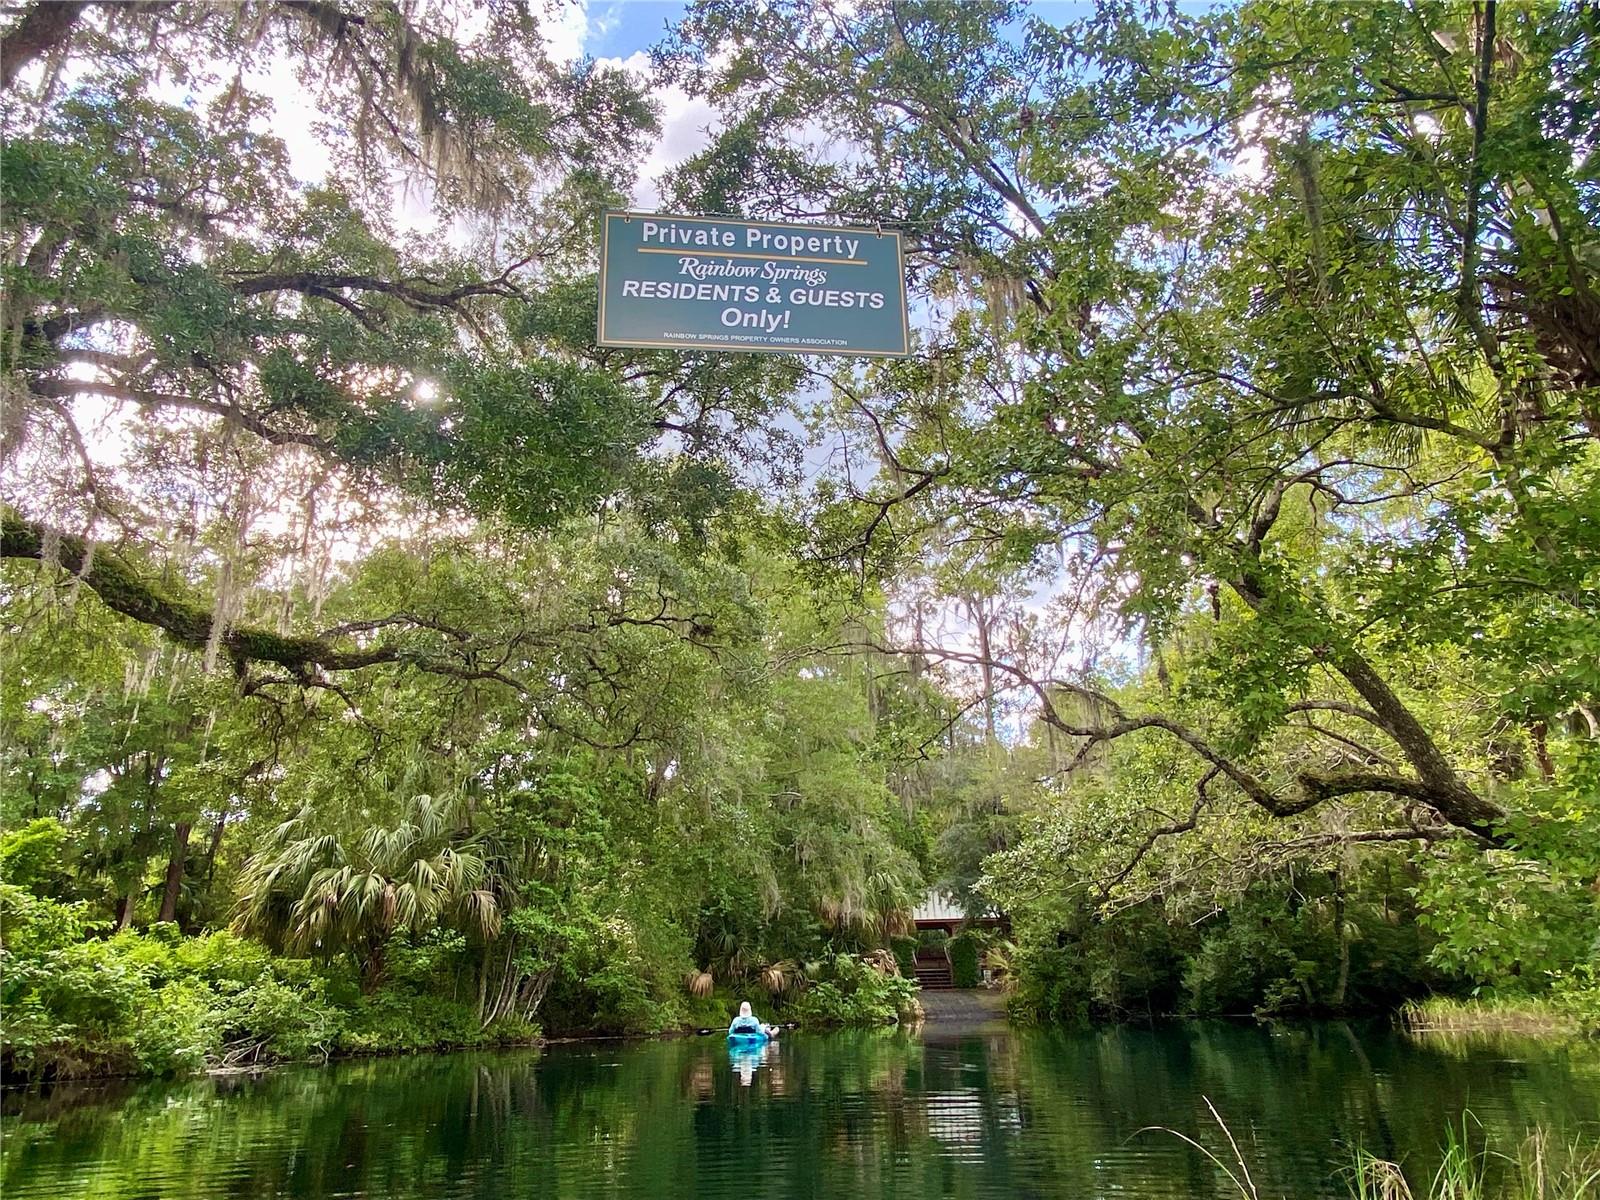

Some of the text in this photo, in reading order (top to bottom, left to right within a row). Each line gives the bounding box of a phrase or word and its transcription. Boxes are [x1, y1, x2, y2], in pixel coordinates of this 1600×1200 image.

[642, 222, 860, 259] Private Property
[678, 257, 827, 286] Rainbow Springs
[622, 280, 885, 309] RESIDENTS & GUESTS
[721, 307, 791, 333] Only!
[663, 332, 848, 346] RAINBOW SPRINGS PROPERTY OWNERS ASSOCIATION
